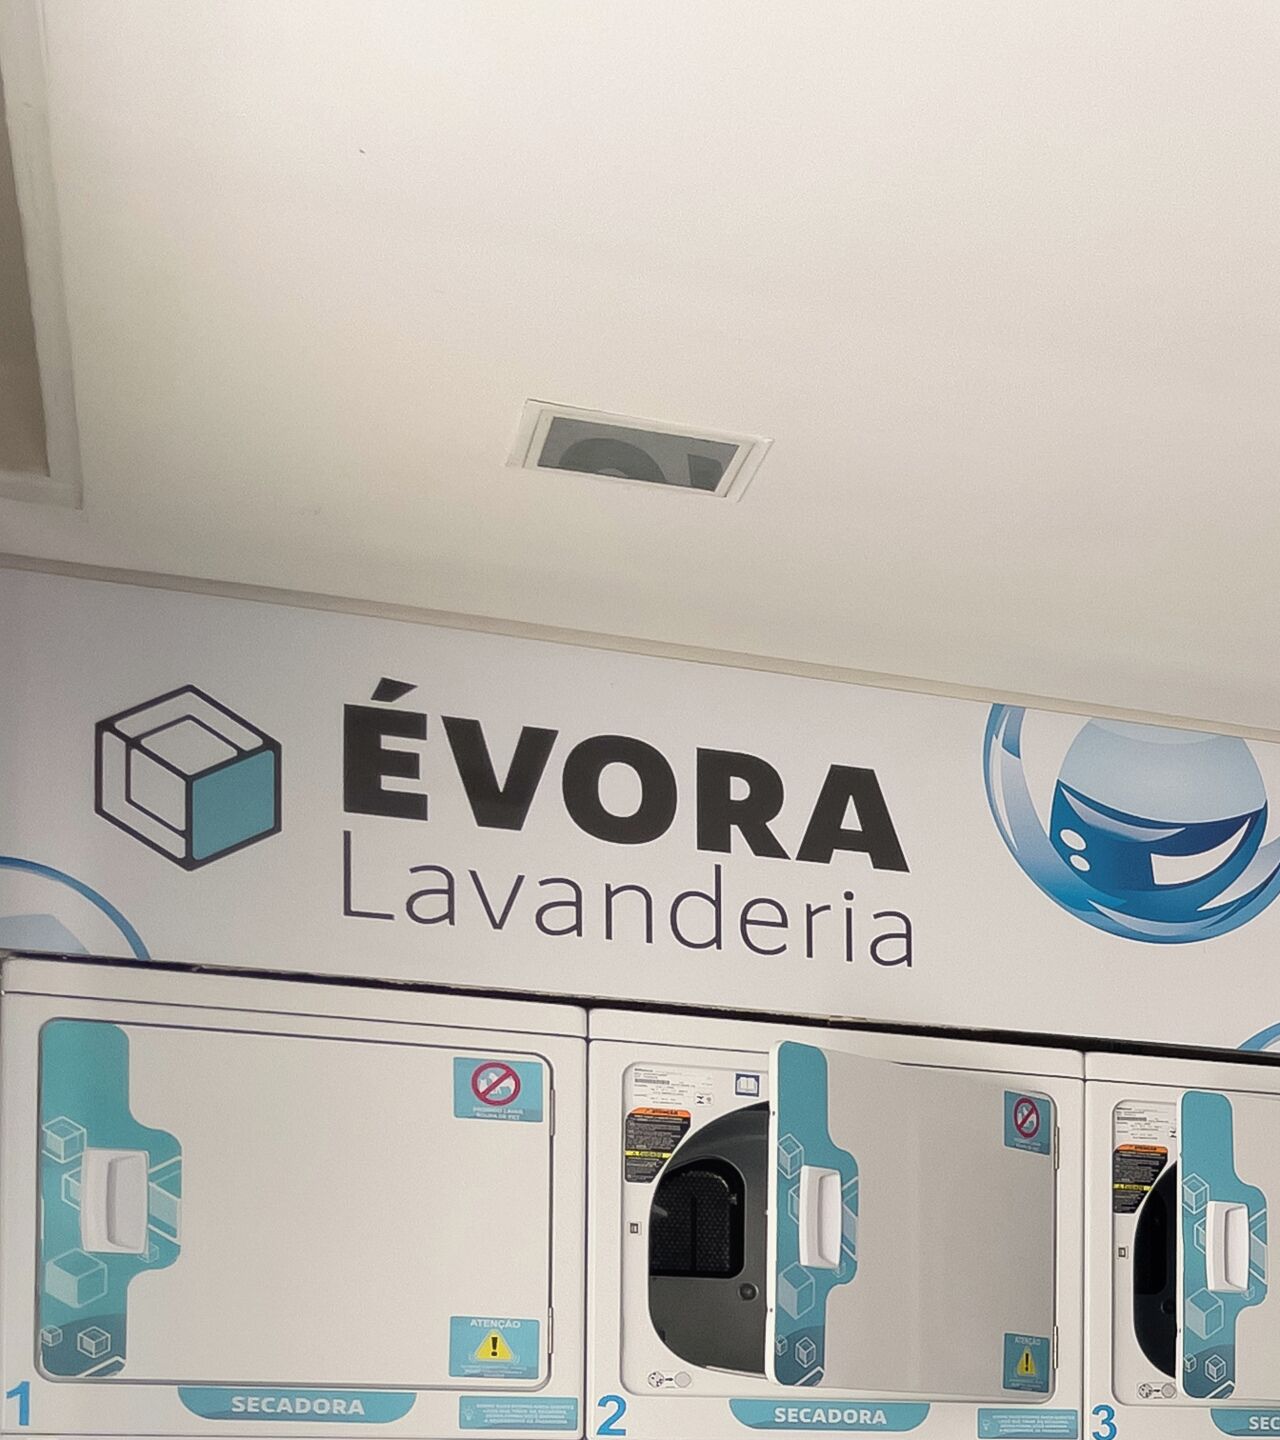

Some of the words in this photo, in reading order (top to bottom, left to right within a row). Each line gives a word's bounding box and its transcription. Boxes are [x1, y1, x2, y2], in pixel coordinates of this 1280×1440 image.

[344, 677, 910, 873] ÉVORA
[344, 830, 913, 967] Lavanderia
[470, 1319, 521, 1330] ATENÇÃO
[6, 1381, 30, 1426] 1
[232, 1395, 366, 1417] SECADORA
[597, 1395, 627, 1436] 2
[774, 1406, 888, 1426] SECADORA
